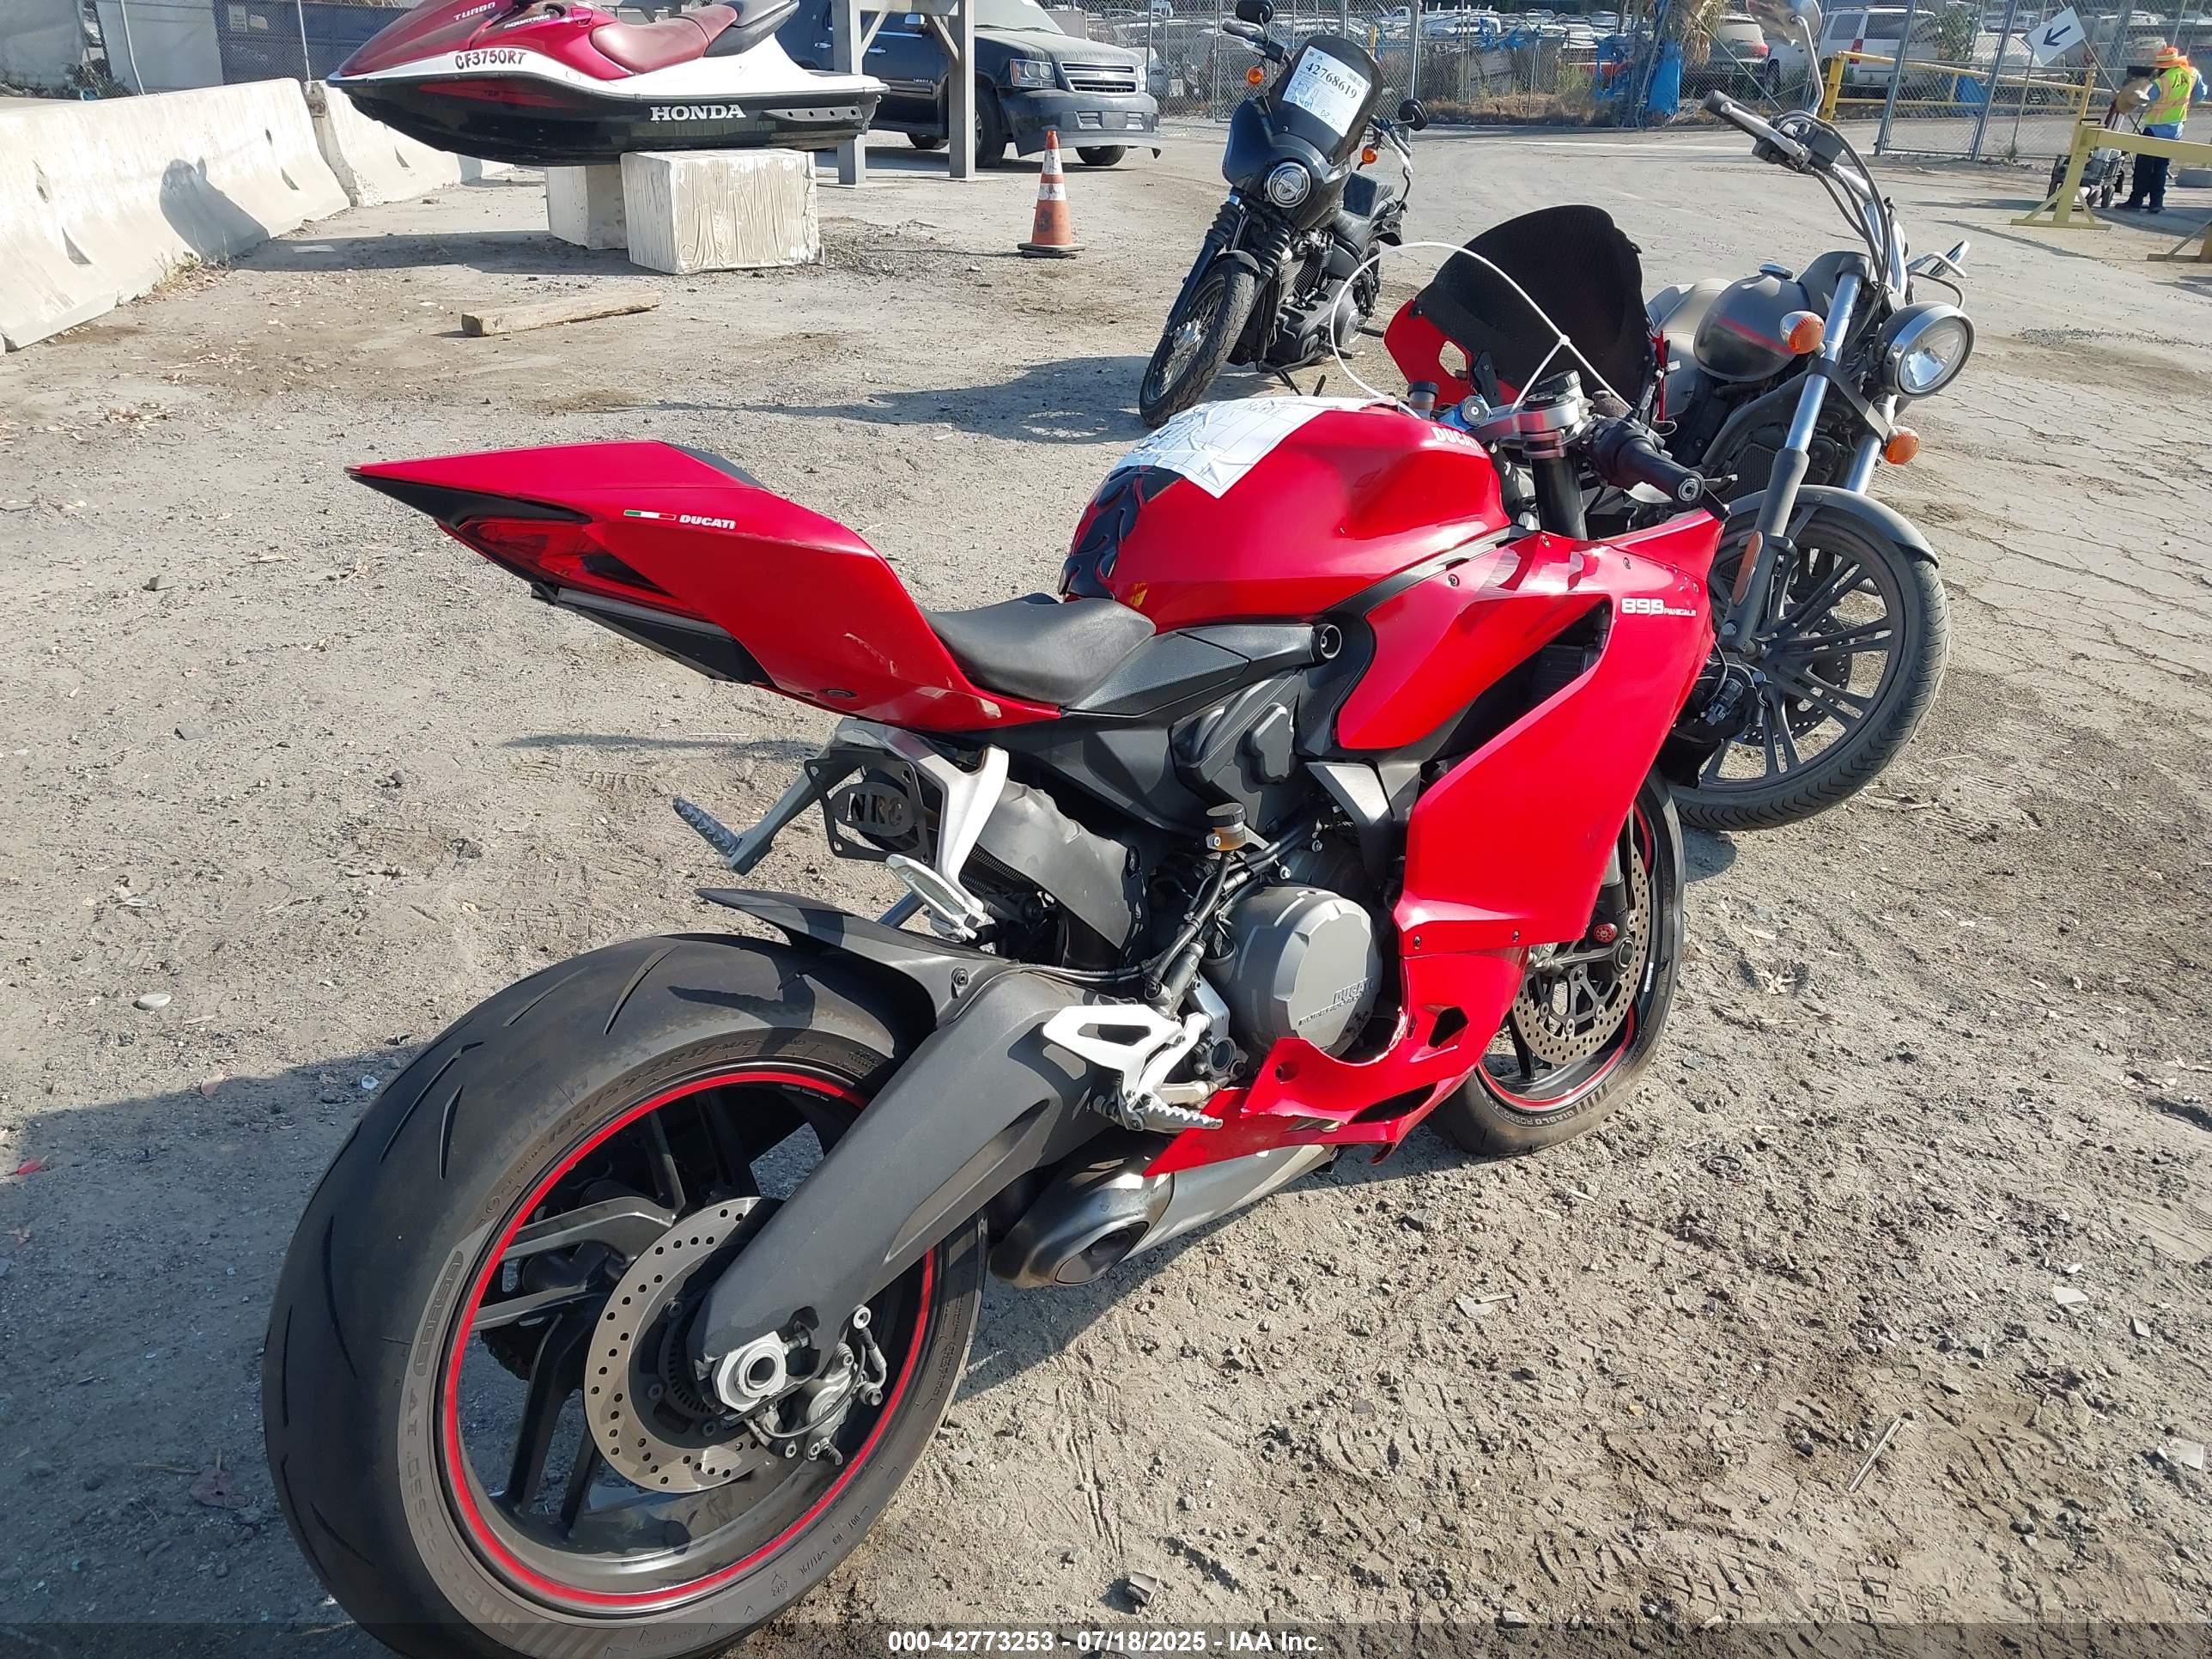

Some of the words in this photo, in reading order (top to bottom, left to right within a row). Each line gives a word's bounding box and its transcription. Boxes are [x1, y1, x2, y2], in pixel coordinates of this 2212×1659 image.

[455, 49, 526, 70] CF3750RT
[1305, 62, 1358, 99] 42768619
[650, 104, 746, 121] HONDA
[678, 514, 737, 530] DUCATI
[846, 793, 902, 825] NRC
[1503, 1110, 1534, 1126] ROSSO
[1534, 1109, 1576, 1126] DIABLO
